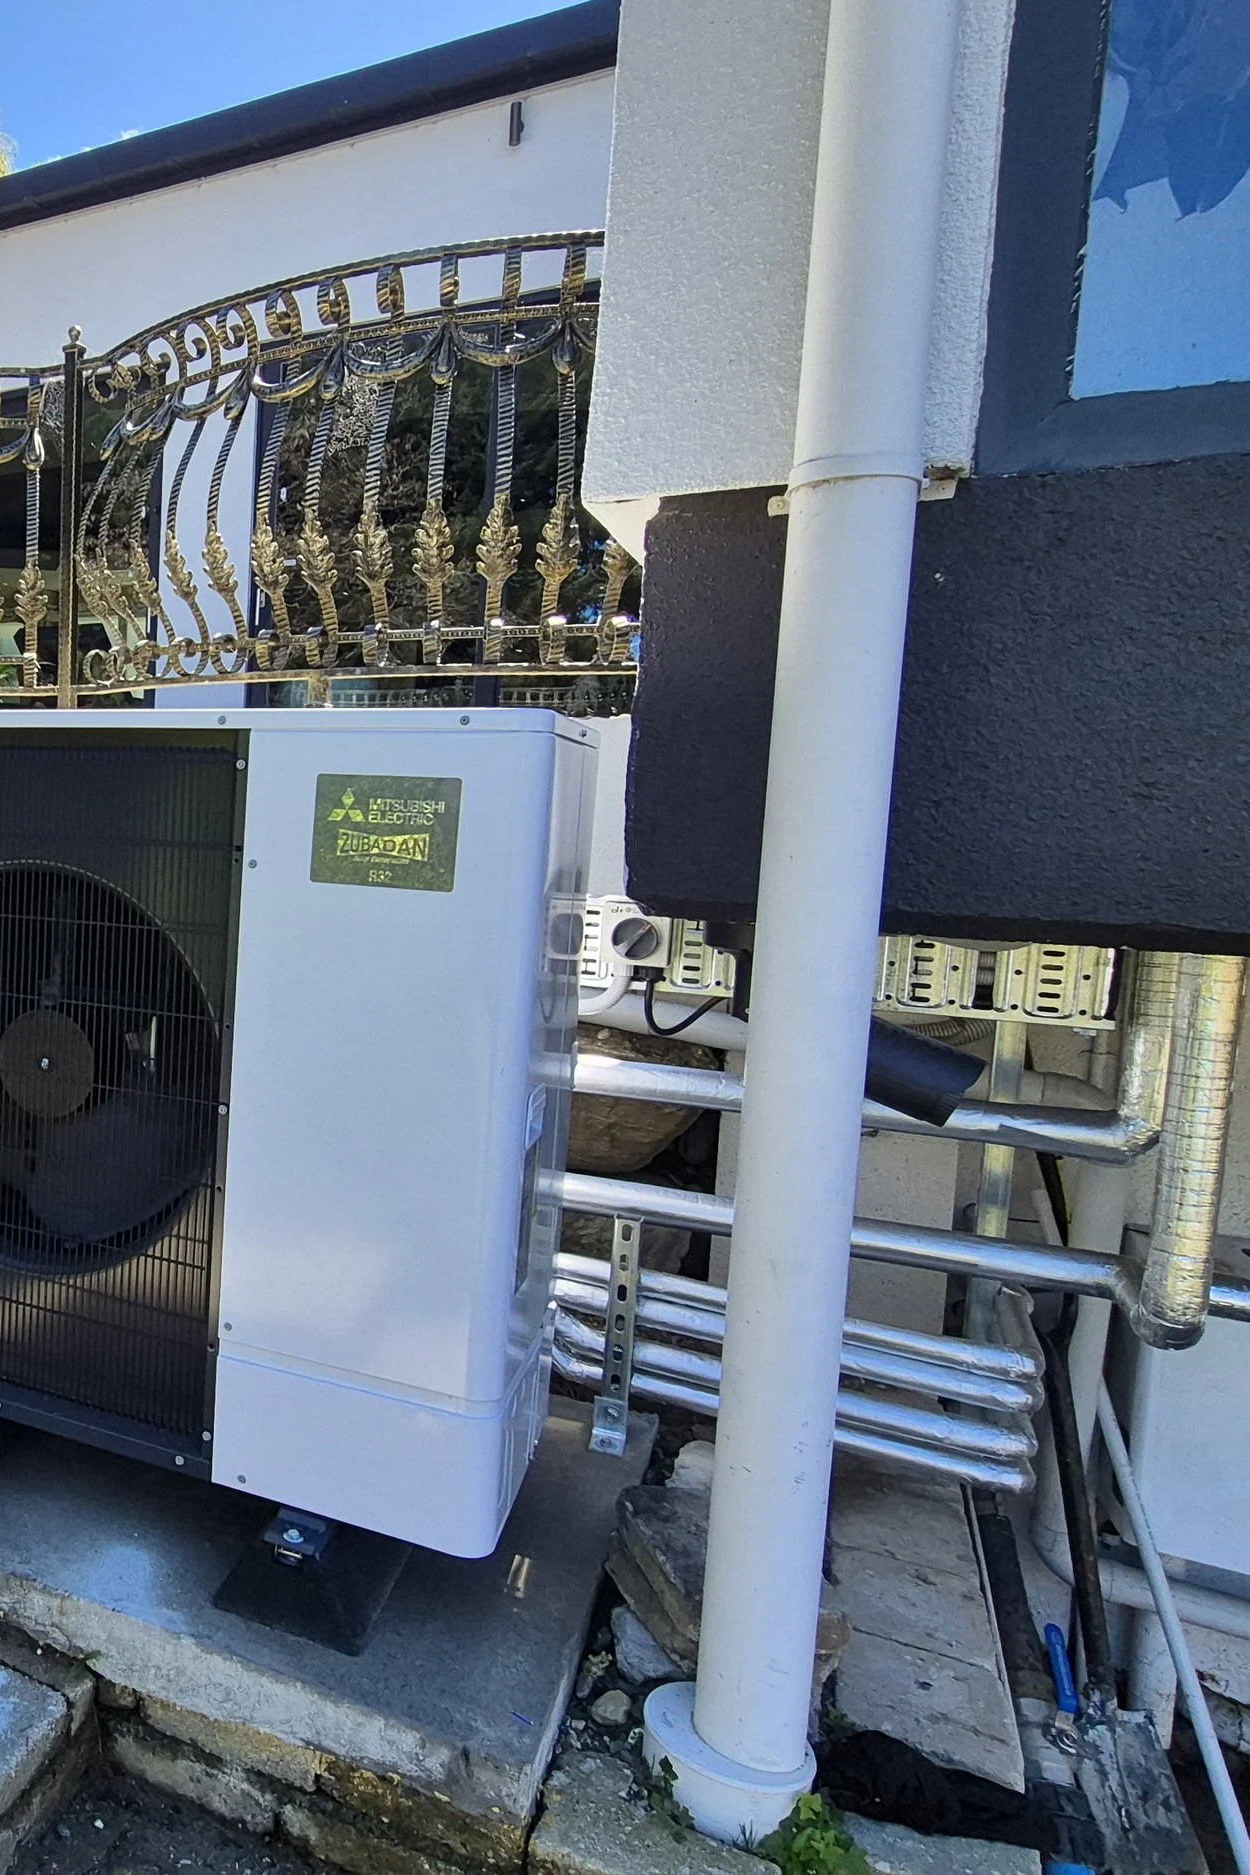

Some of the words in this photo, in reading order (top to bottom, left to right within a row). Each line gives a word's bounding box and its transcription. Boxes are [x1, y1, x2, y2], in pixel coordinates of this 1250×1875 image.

[368, 798, 446, 814] MITSUBISHI
[368, 810, 435, 826] ELECTRIC
[338, 832, 428, 859] ZUBADAN
[368, 869, 392, 883] R32
